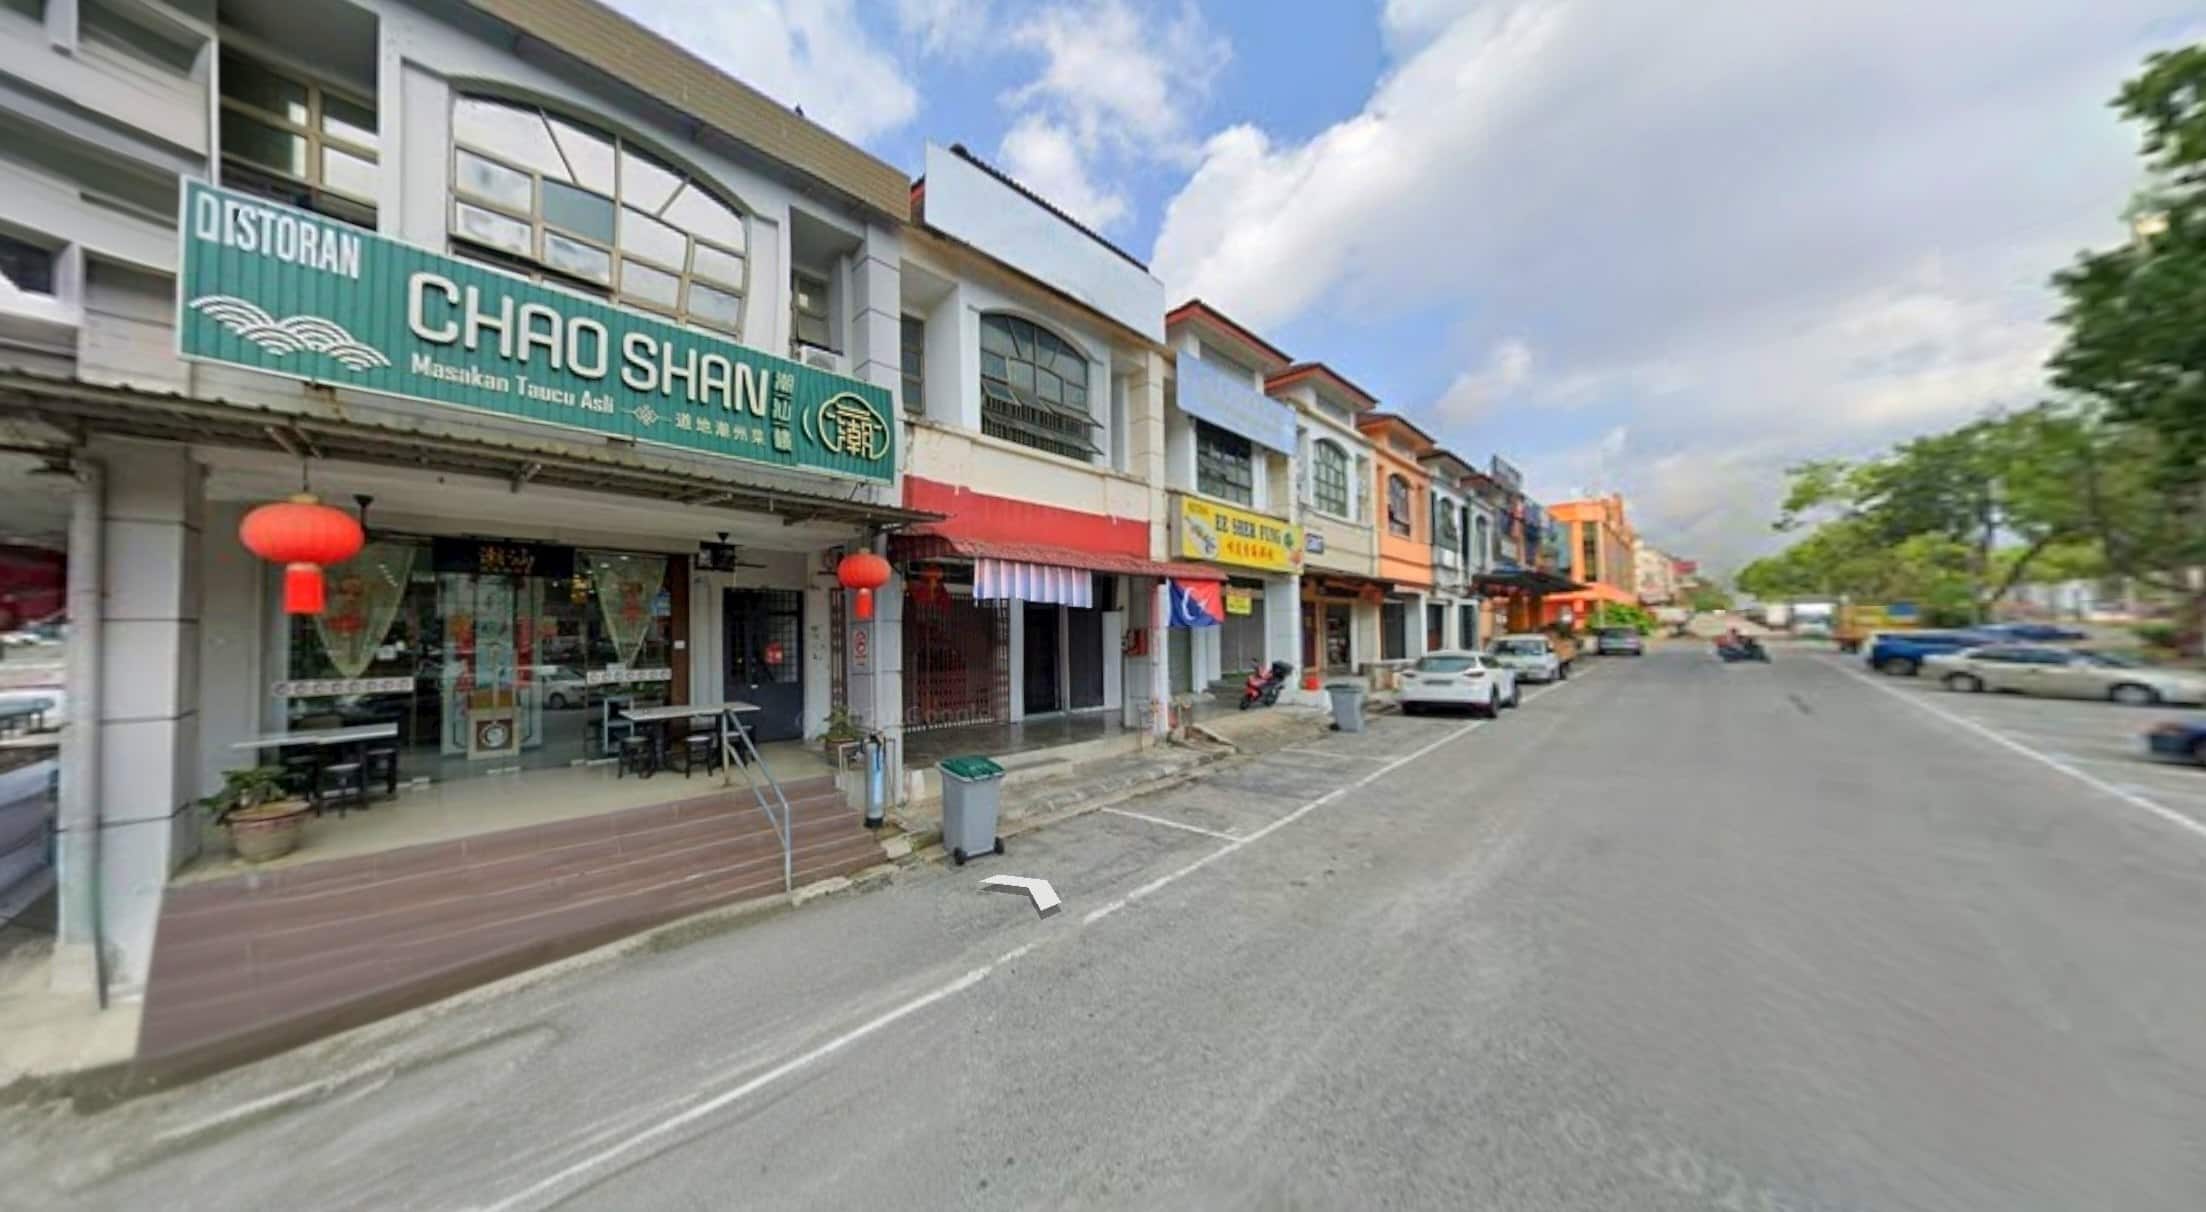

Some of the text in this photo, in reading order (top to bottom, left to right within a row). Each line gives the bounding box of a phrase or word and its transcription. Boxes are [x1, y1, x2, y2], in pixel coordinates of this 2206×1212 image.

[407, 271, 769, 418] CHAO SHAN
[411, 353, 615, 414] Masakan Taucu Asli
